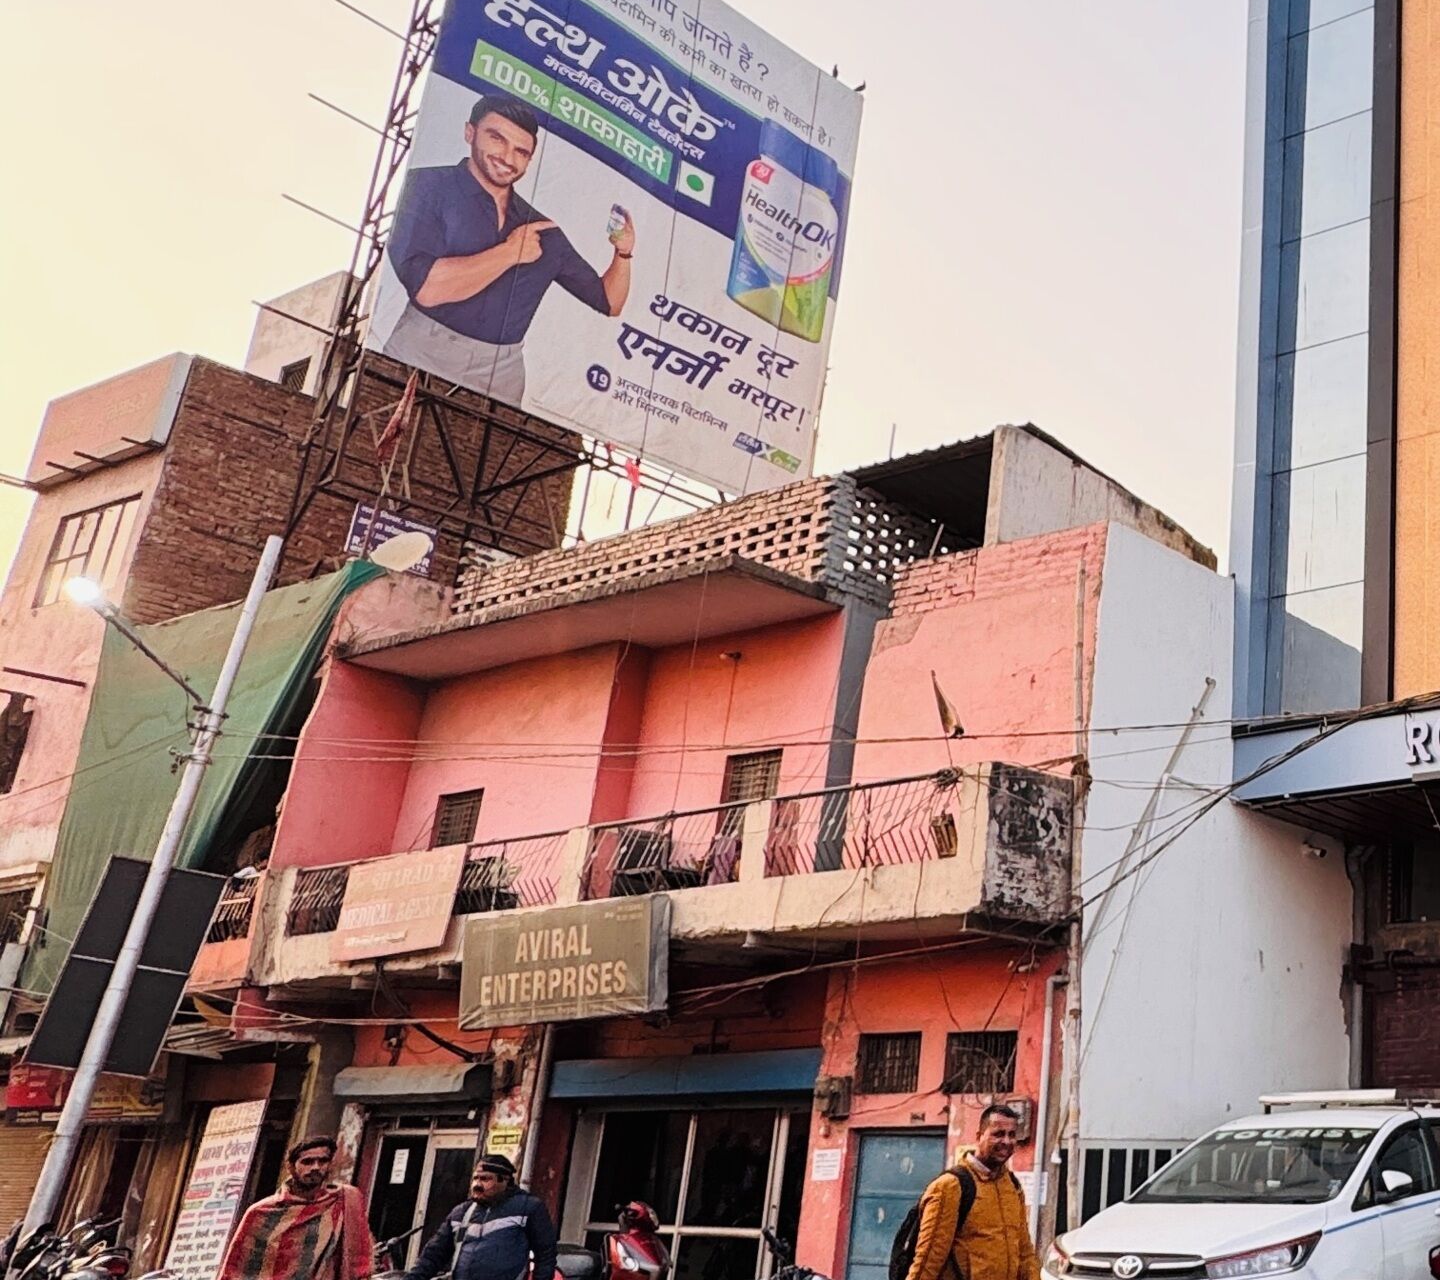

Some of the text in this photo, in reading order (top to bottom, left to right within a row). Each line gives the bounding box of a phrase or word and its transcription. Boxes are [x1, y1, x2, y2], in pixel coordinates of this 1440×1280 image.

[683, 10, 733, 60] जानते
[479, 53, 667, 176] 100% शाकाहारी
[607, 57, 723, 141] ओके
[617, 322, 731, 390] एनर्जी
[649, 293, 799, 379] थकान दूर
[589, 369, 608, 390] 19
[514, 924, 592, 964] AVIRAL
[480, 960, 627, 1007] ENTERPRISES
[1215, 1128, 1373, 1141] TOURIST
